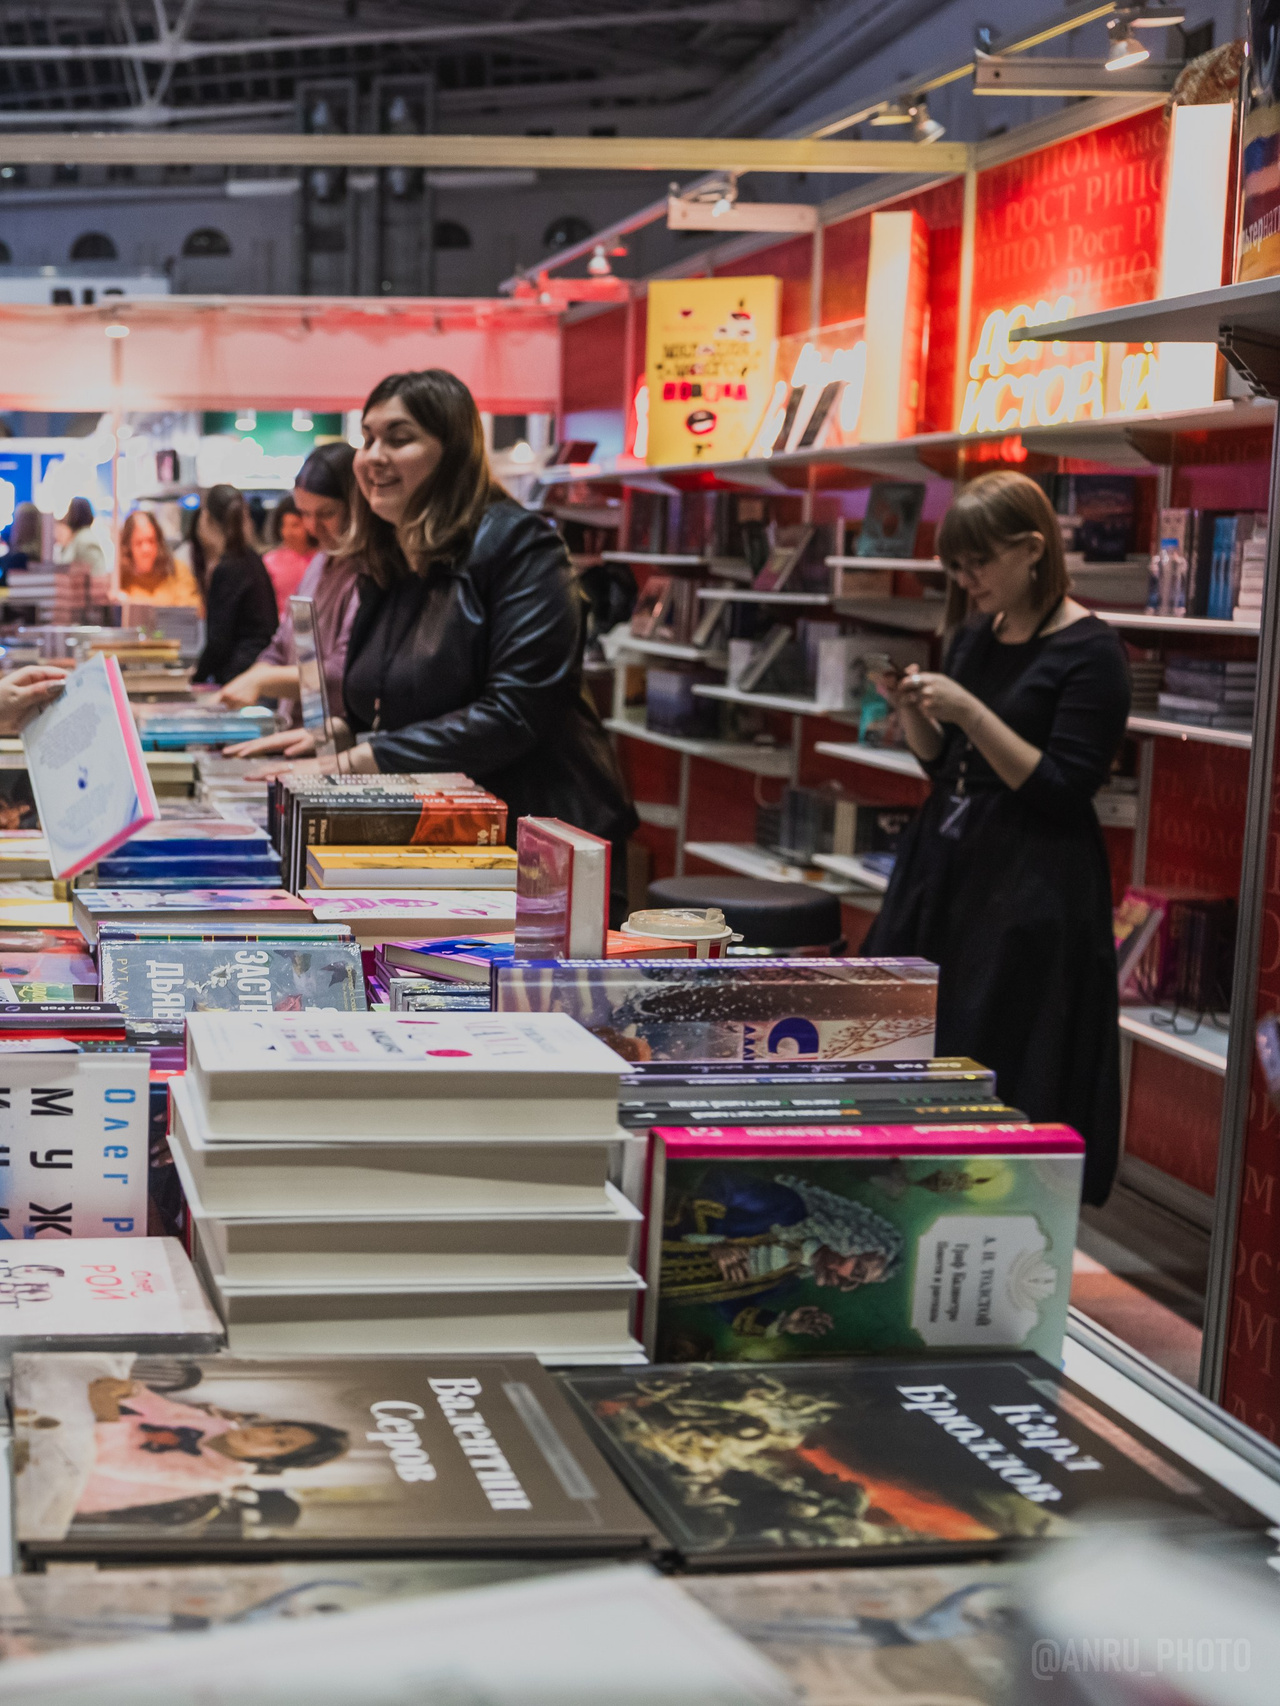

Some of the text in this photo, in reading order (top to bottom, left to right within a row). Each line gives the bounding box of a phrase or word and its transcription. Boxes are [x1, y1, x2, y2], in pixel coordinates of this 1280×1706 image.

[28, 1087, 74, 1237] МУЖ
[103, 1088, 137, 1185] Олег
[80, 1264, 139, 1301] РОЙ
[975, 1267, 995, 1327] ТОЛСТОЙ
[365, 1398, 437, 1485] Серов
[426, 1375, 533, 1512] Валентин
[895, 1383, 1062, 1505] Брюллов
[990, 1402, 1104, 1474] Карл
